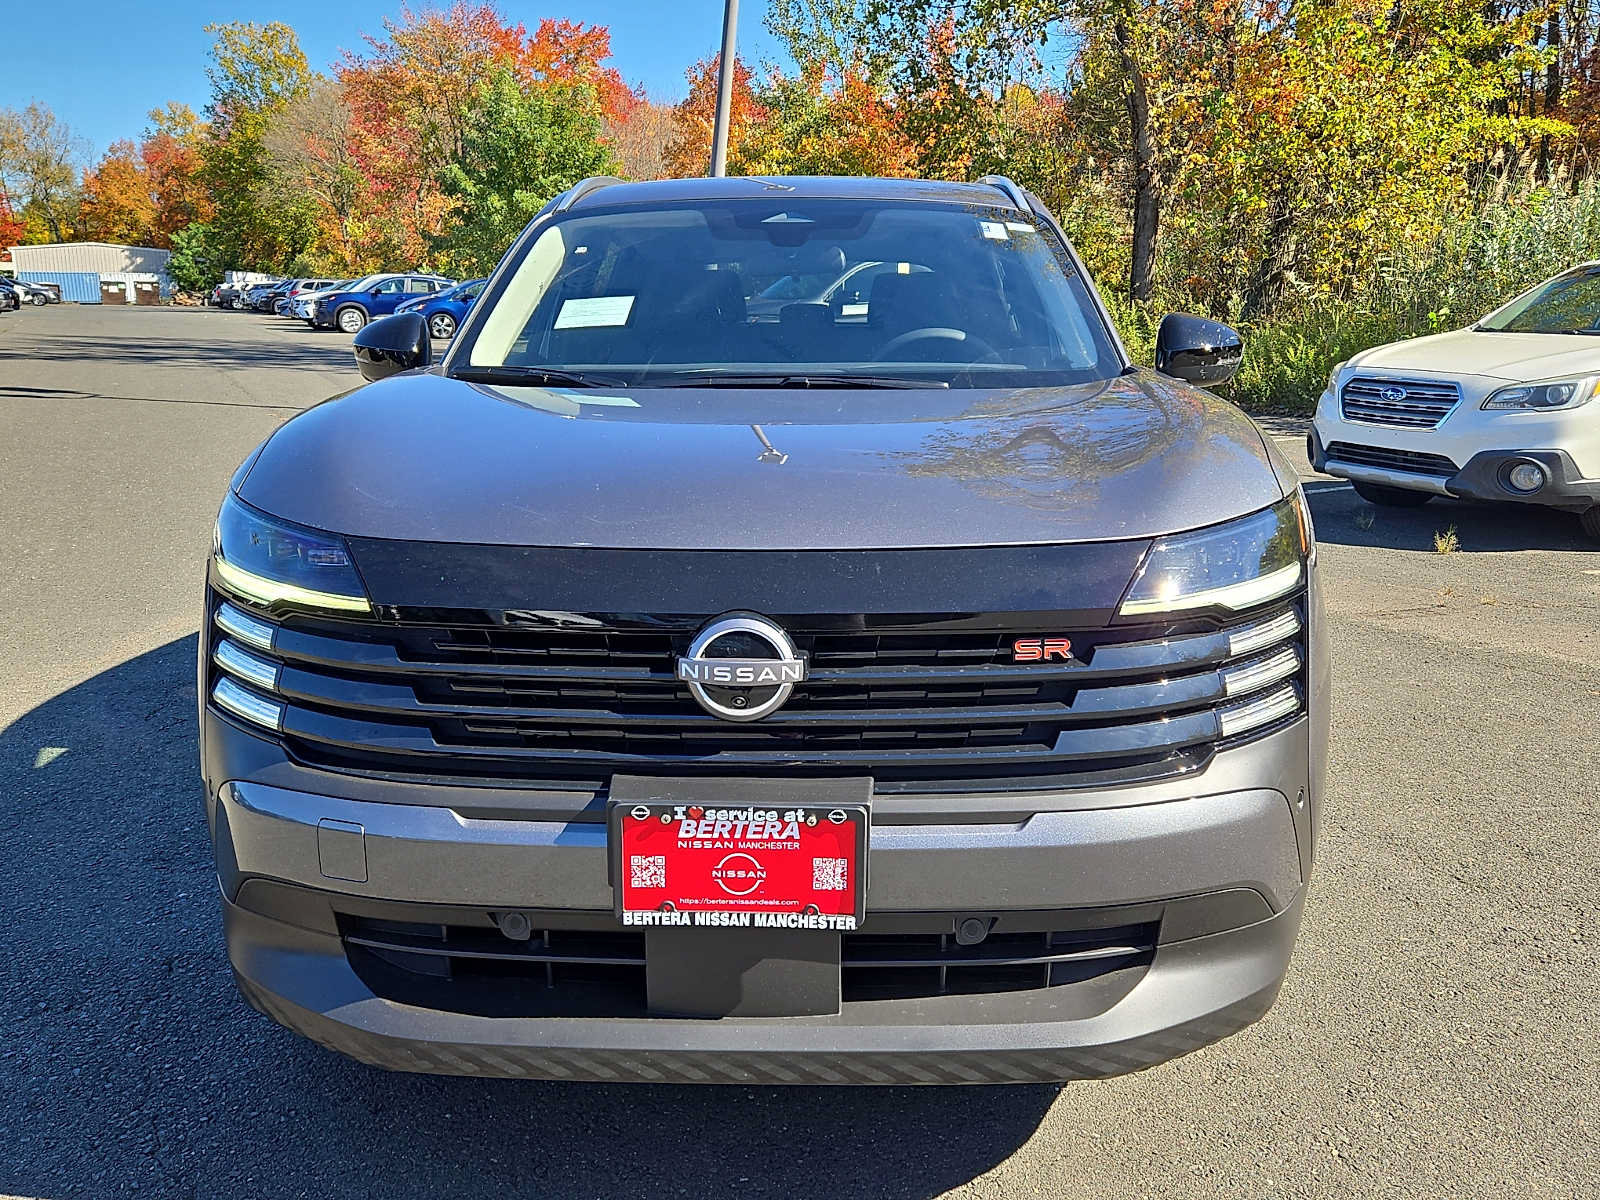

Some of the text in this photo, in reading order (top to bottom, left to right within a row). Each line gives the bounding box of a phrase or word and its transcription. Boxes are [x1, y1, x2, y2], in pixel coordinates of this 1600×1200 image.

[1014, 638, 1073, 660] SR
[681, 663, 800, 682] NISSAN
[673, 806, 805, 823] I service at
[677, 820, 801, 840] BERTERA
[677, 840, 800, 850] NISSAN MANCHESTER
[711, 870, 767, 878] NISSAN
[679, 898, 800, 906] https://berteranissandeals.com
[622, 911, 857, 930] BERTERA NISSAN MANCHESTER
